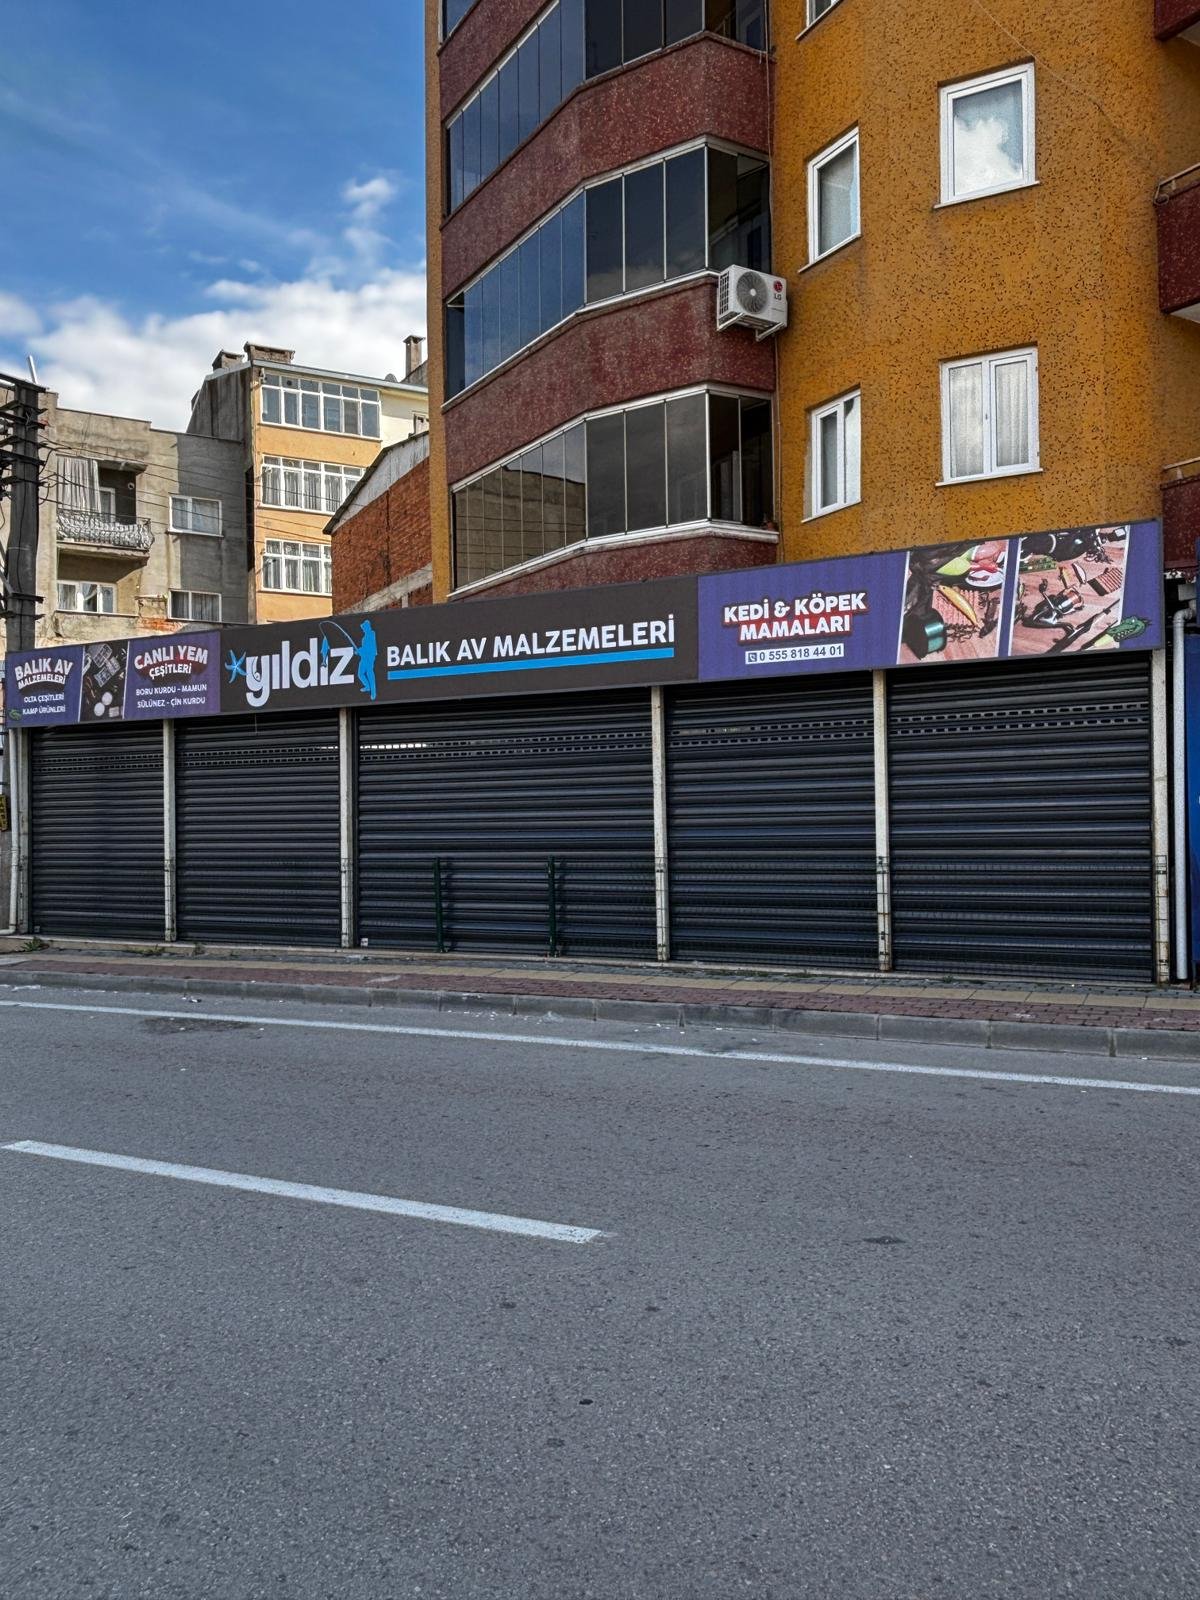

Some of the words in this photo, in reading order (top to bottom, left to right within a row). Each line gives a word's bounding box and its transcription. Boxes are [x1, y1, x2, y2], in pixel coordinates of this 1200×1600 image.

[724, 599, 770, 622] KEDİ
[774, 601, 790, 618] &
[794, 593, 866, 616] KÖPEK
[740, 615, 850, 641] MAMALARI
[387, 640, 451, 667] BALIK
[457, 637, 487, 661] AV
[493, 614, 675, 658] MALZEMELERİ
[134, 645, 174, 670] CANLI
[177, 645, 209, 665] YEM
[759, 652, 766, 661] 0
[769, 650, 788, 660] 555
[790, 648, 810, 659] 818
[813, 647, 827, 657] 44
[829, 645, 843, 656] 01
[14, 657, 52, 681] BALIK
[54, 659, 74, 676] AV
[148, 662, 192, 680] ÇEŞİTLERİ
[18, 674, 66, 690] MALZEMELERİ
[135, 688, 153, 696] BORU
[154, 686, 176, 695] KURDU
[182, 684, 207, 693] MAMUN
[24, 694, 37, 703] OLTA
[38, 692, 65, 703] ÇEŞİTLERİ
[170, 697, 182, 707] ÇİN
[183, 697, 206, 705] KURDU
[22, 707, 38, 715] KAMP
